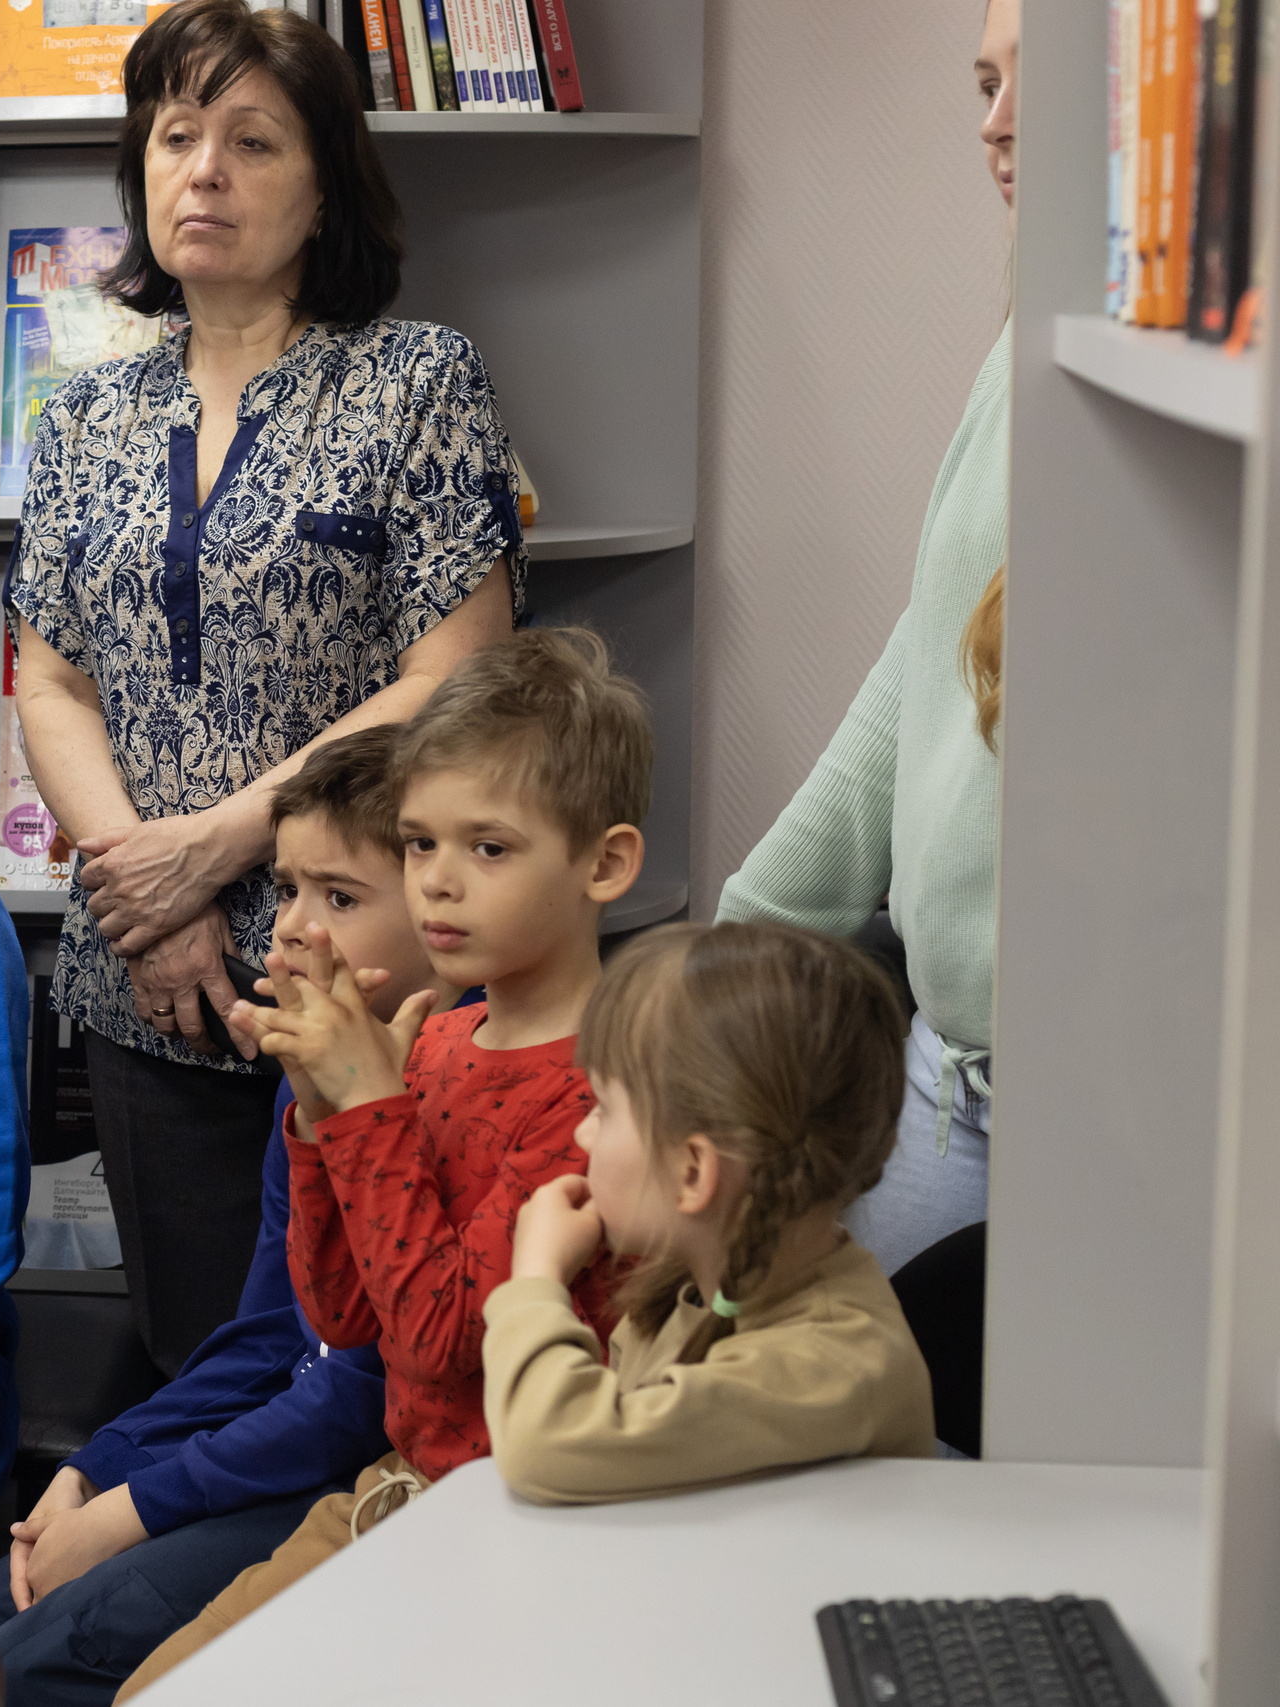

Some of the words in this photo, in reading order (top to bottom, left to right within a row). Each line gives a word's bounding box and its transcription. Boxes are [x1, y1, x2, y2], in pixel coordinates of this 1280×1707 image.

[367, 0, 383, 47] ИЗНУТ
[448, 10, 458, 38] РУССКОЙ
[485, 16, 495, 45] ДРЕВНИХ
[551, 22, 558, 31] О
[43, 36, 103, 51] Покоритель
[474, 25, 484, 53] ИСТОРИЯ
[508, 23, 518, 51] РУССКАЯ
[519, 12, 532, 60] ГРАЖДАНСКАЯ
[553, 33, 563, 51] ВСЕ
[67, 54, 80, 65] на
[81, 53, 121, 66] дачном
[54, 1178, 101, 1189] Ингеборга
[53, 1186, 106, 1197] Дапкунайте
[53, 1196, 80, 1206] Театр
[52, 1211, 89, 1221] границы
[53, 1204, 110, 1214] переступает
